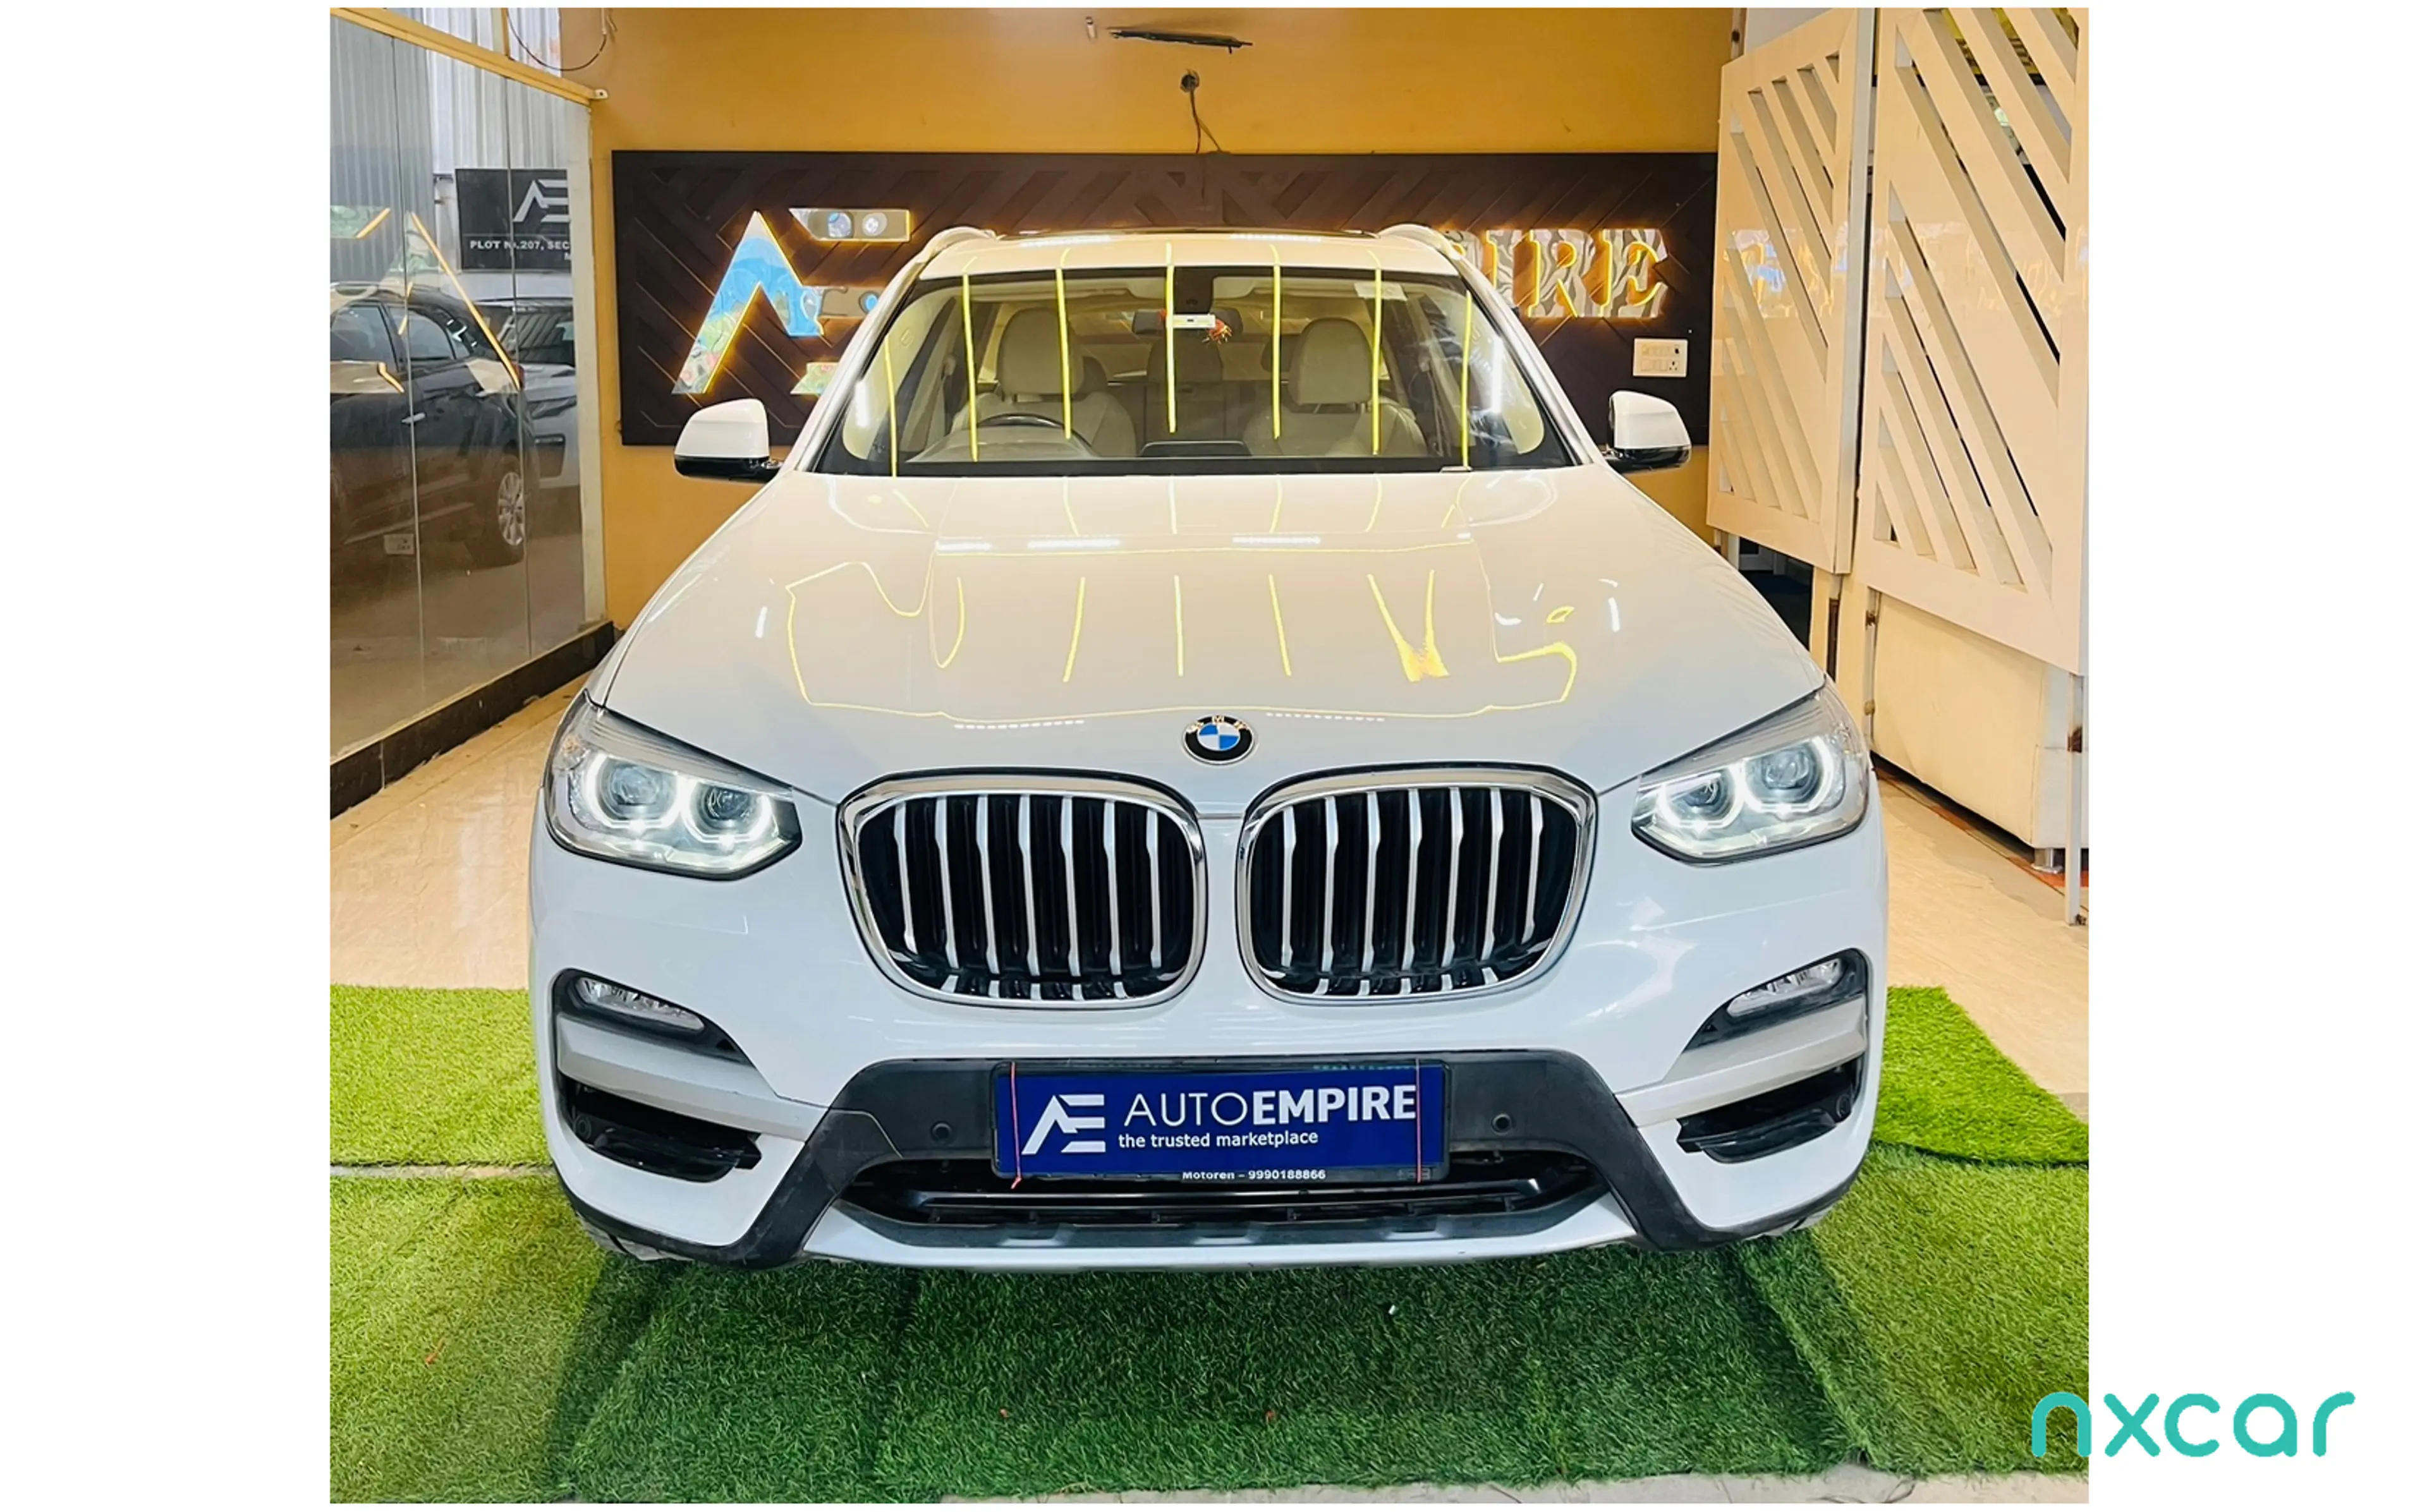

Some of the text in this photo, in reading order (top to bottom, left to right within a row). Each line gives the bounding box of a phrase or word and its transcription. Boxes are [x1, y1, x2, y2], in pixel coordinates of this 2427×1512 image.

[470, 240, 501, 250] PLOT
[1124, 1085, 1416, 1127] AUTOEMPIRE
[1118, 1130, 1318, 1148] the trusted marketplace
[1183, 1171, 1234, 1180] Motoren
[1248, 1170, 1326, 1180] 9990188866
